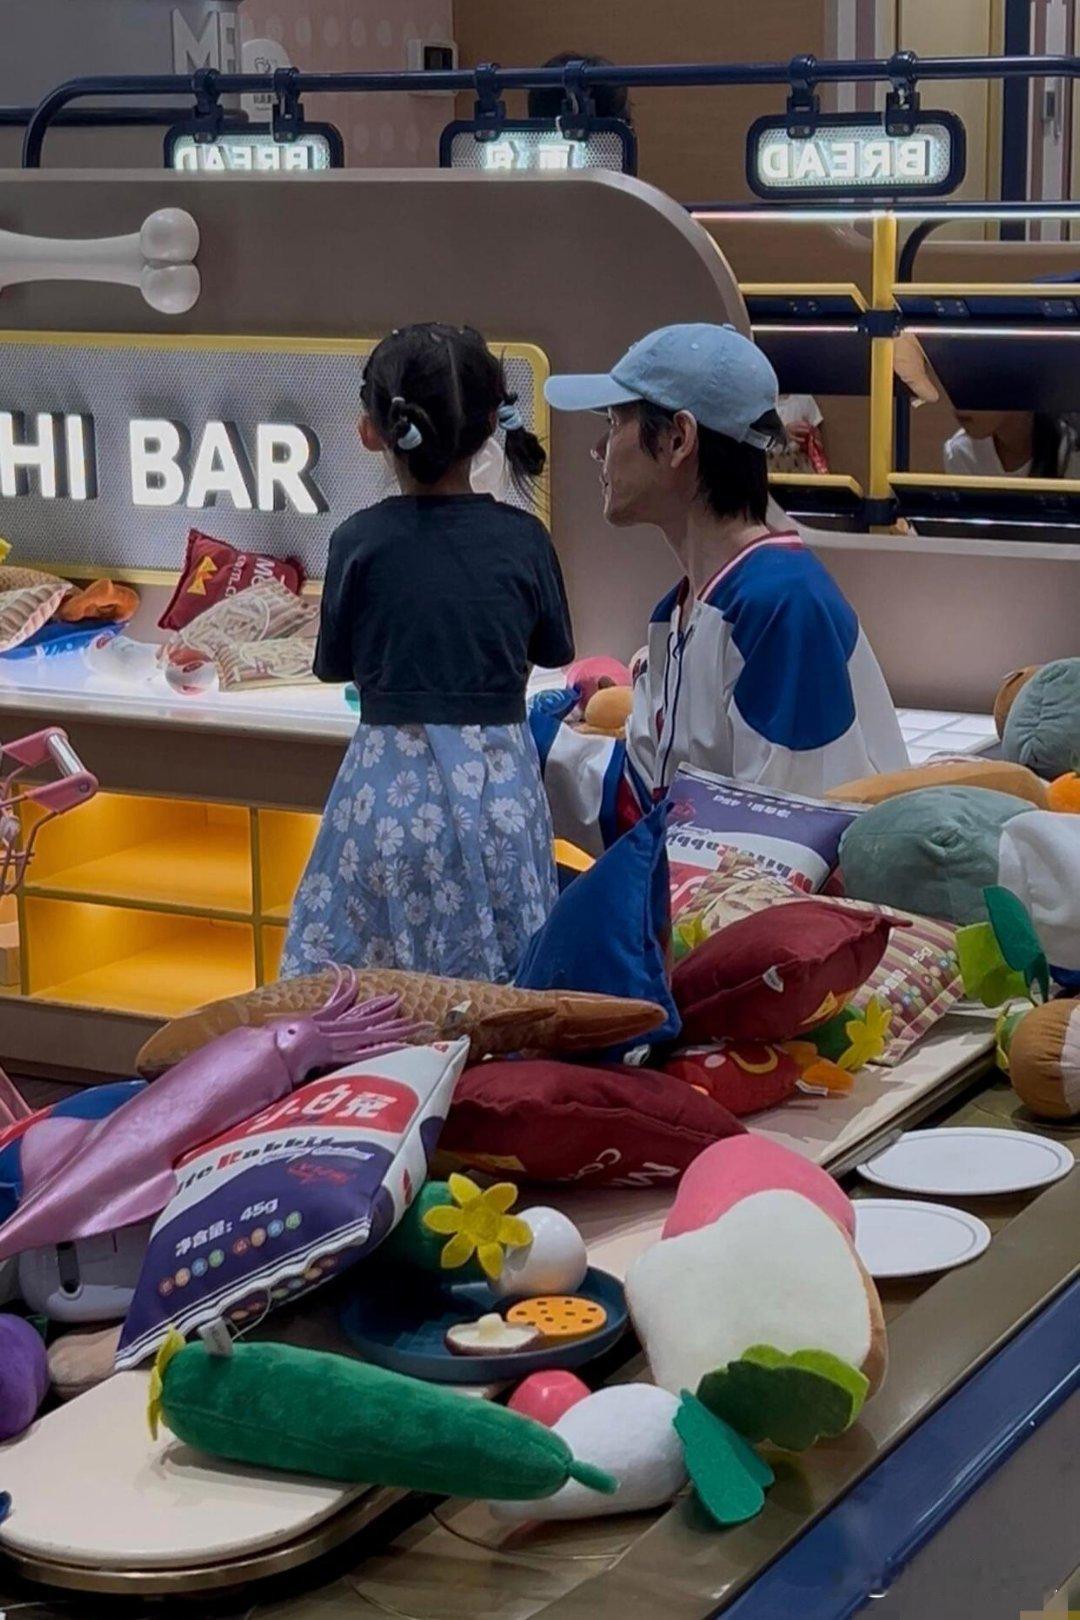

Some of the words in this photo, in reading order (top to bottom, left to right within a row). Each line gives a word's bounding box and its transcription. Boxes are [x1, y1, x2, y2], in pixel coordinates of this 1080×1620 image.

[0, 411, 87, 500] HI
[129, 419, 320, 515] BAR
[239, 1198, 279, 1222] 45g
